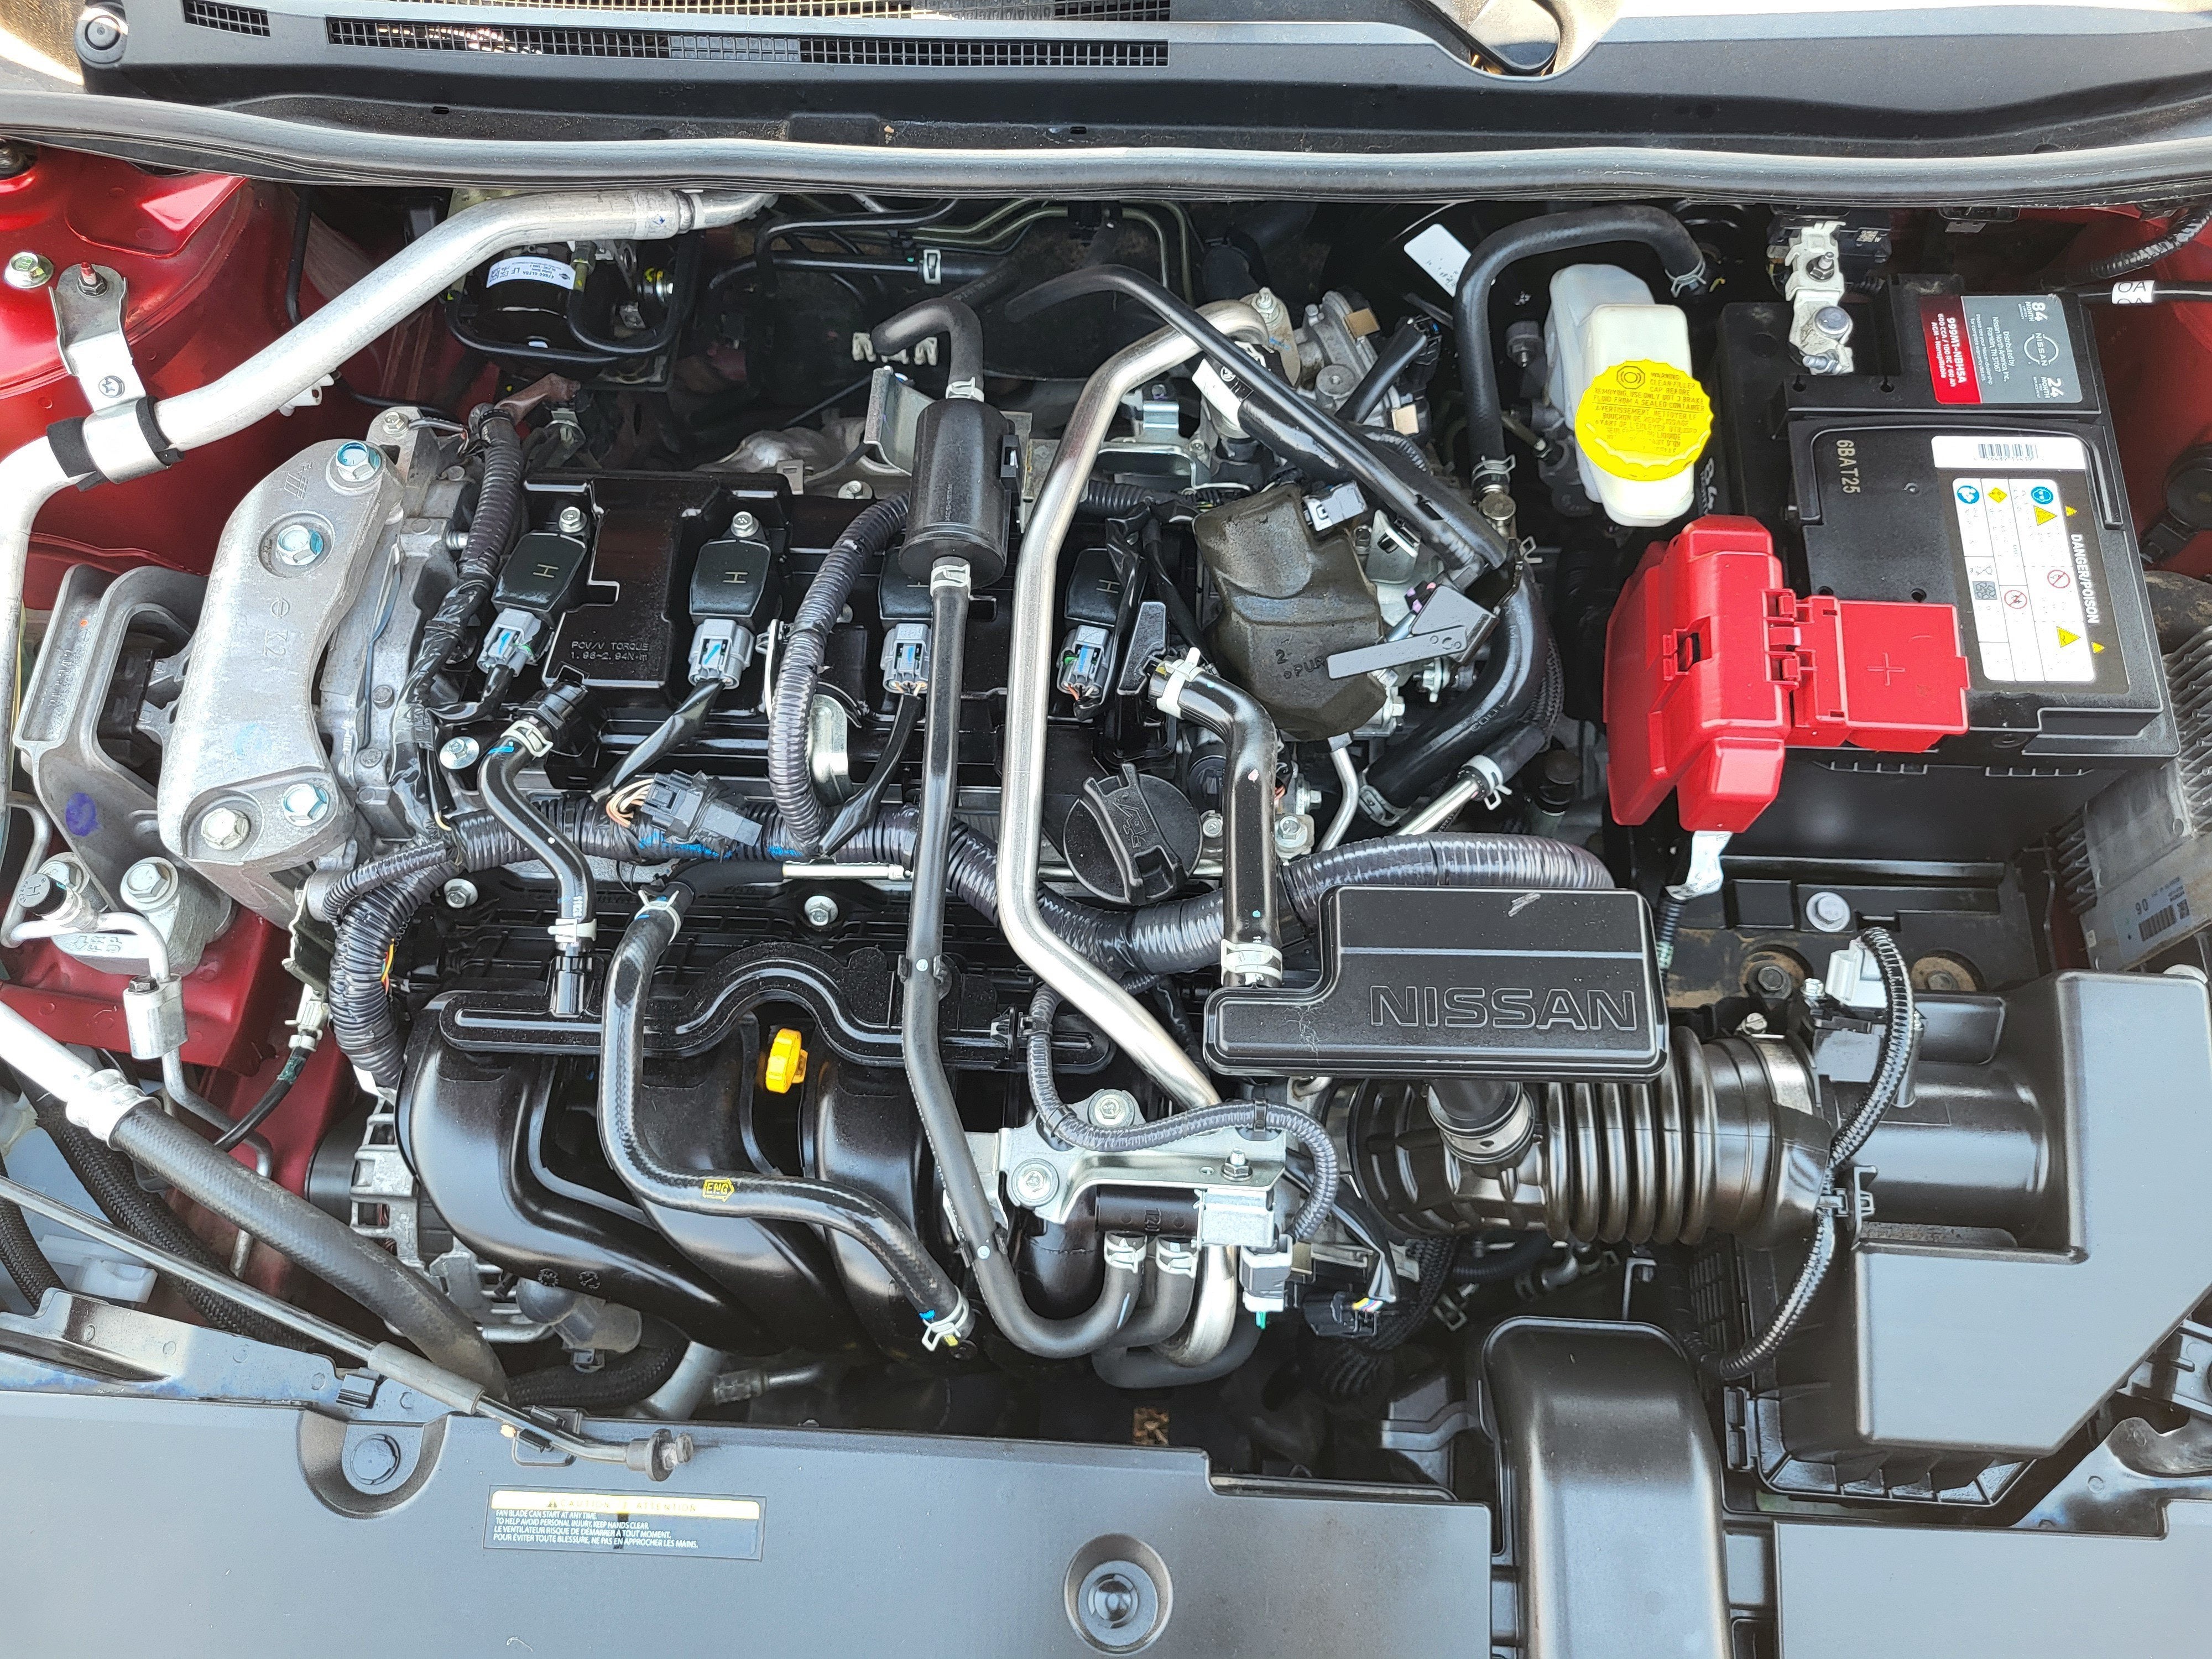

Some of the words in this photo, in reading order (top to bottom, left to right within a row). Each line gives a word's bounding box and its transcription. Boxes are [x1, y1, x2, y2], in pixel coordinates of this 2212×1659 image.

[2117, 281, 2147, 293] OA
[2025, 301, 2034, 321] MONTH
[2031, 302, 2049, 321] 84
[1931, 322, 1939, 335] AGM
[1992, 316, 2001, 333] Nissan
[1970, 325, 1979, 345] complete
[1995, 334, 2004, 349] North
[1985, 327, 1995, 347] Franklin,
[1992, 357, 2000, 372] 37067
[2002, 331, 2015, 358] Distributed
[2034, 332, 2047, 366] NISSAN
[1933, 341, 1947, 378] Nonspillable
[1974, 346, 1983, 365] warranty
[1997, 349, 2008, 371] America,
[1949, 378, 1957, 387] Ah
[1984, 363, 1993, 384] dealership
[1666, 388, 1690, 396] BEFORE
[1672, 381, 1695, 390] FILLER
[2040, 377, 2050, 398] MONTH
[2047, 377, 2065, 397] 24
[1682, 397, 1704, 405] BRAKE
[1836, 440, 1860, 494] 6BAT25
[2070, 534, 2100, 624] DANGER/POISON
[611, 642, 649, 651] TORQUE
[1370, 985, 1637, 1031] NISSAN
[706, 1182, 729, 1194] ENG
[542, 1510, 560, 1519] START
[637, 1501, 696, 1512] ATTENTION
[503, 1525, 545, 1534] VENTILATEUR
[546, 1526, 569, 1535] RISQUE
[580, 1527, 615, 1536] DÉMARRER
[622, 1529, 640, 1537] TOUT
[640, 1529, 671, 1538] MOMENT.
[520, 1517, 539, 1526] AVOID
[540, 1518, 570, 1527] PERSONAL
[607, 1521, 629, 1529] HANDS
[629, 1521, 650, 1530] CLEAR.
[513, 1532, 534, 1542] ÉVITER
[534, 1534, 556, 1542] TOUTE
[623, 1537, 662, 1547] APPROCHER
[675, 1539, 698, 1548] MAINS.
